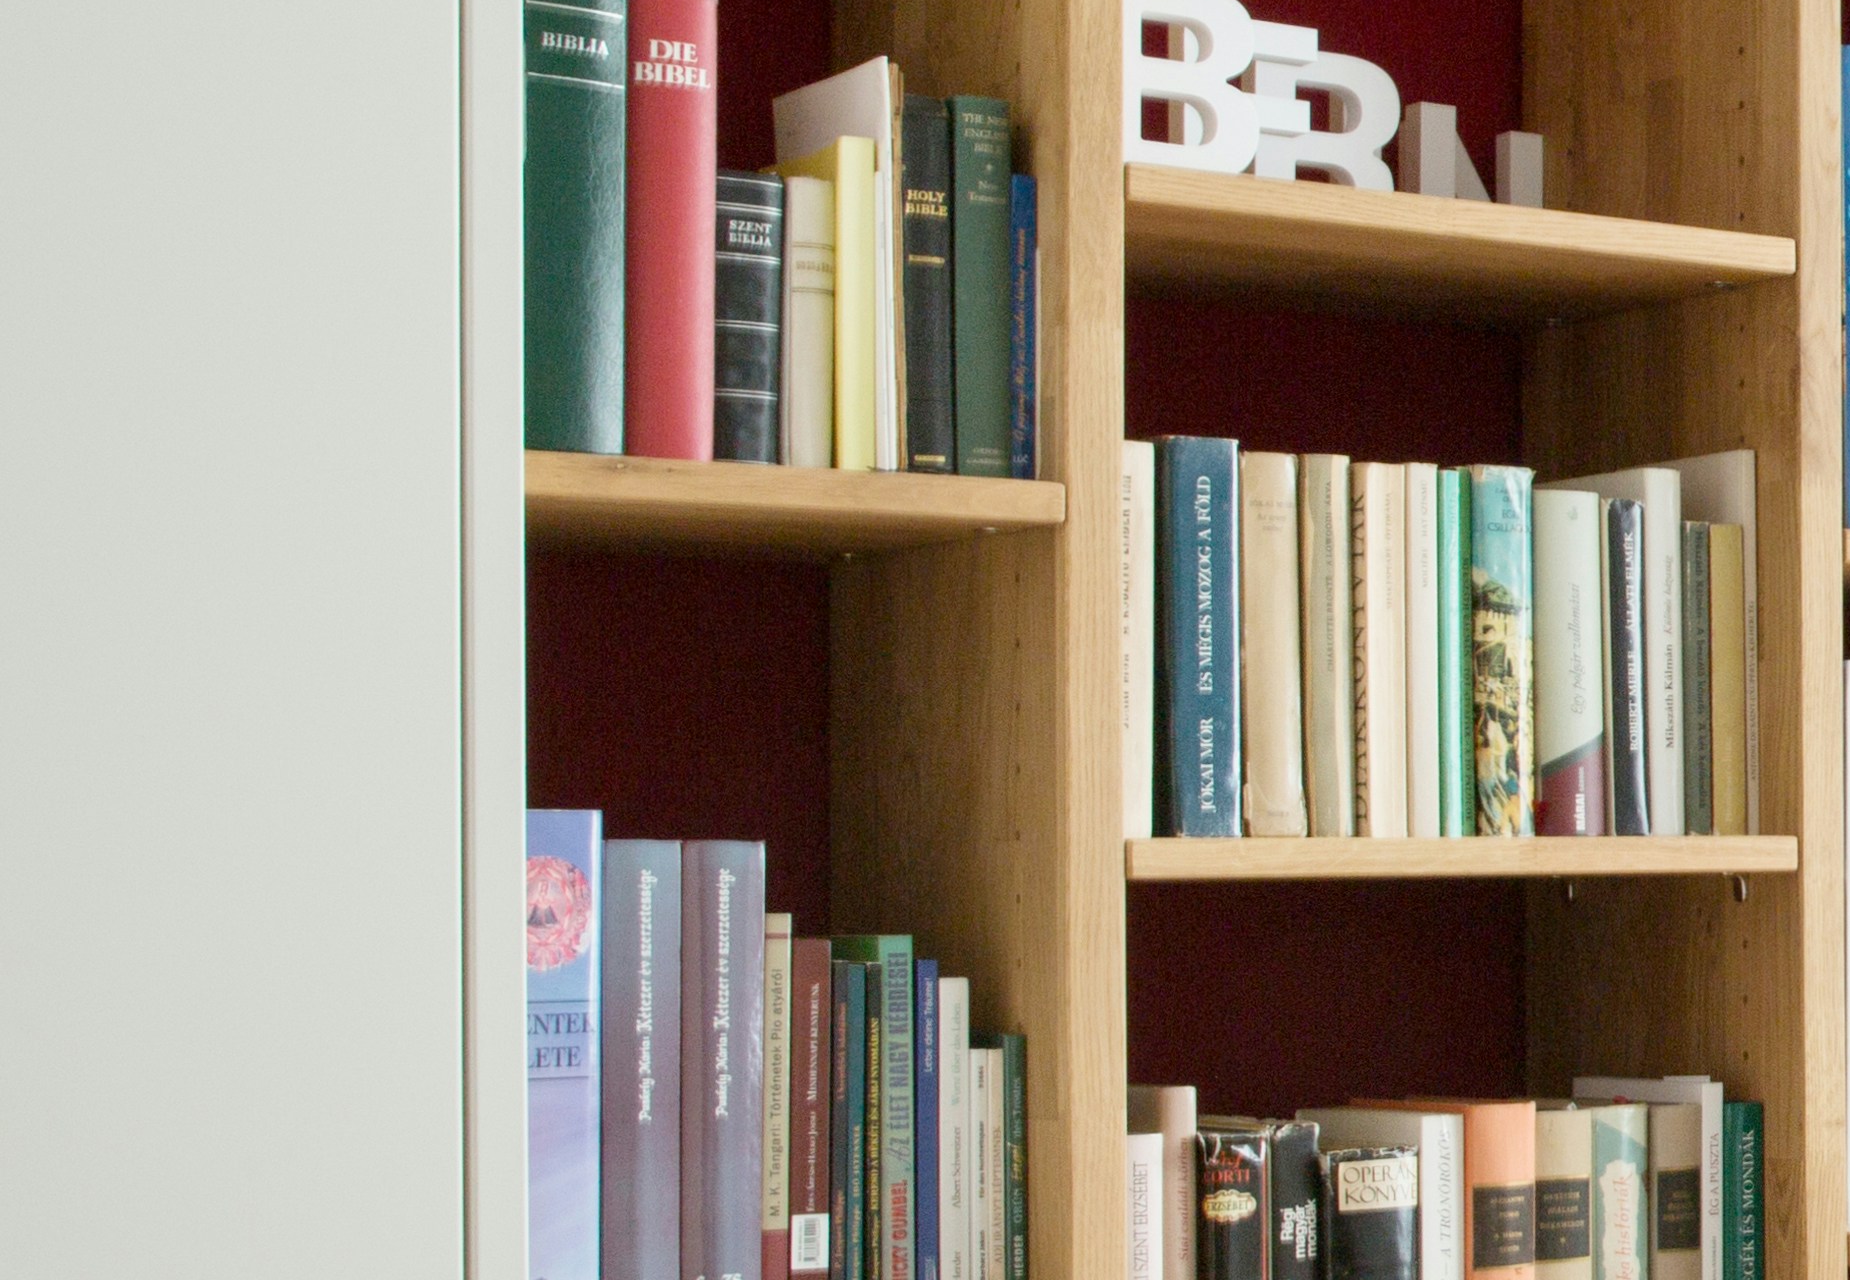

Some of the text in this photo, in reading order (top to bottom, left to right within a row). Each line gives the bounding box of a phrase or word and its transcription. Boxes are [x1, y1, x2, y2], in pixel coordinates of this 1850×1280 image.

[541, 31, 610, 57] BIBLIA
[649, 38, 698, 63] DIE
[633, 61, 712, 89] BIBEL
[906, 188, 945, 203] HOLY
[905, 202, 948, 218] BIBLE
[1196, 474, 1212, 523] FÖLD
[1198, 528, 1212, 542] A
[1196, 545, 1212, 611] MOZOG
[1199, 717, 1214, 758] MÓR
[1200, 762, 1216, 814] JÓKAI
[1279, 1207, 1295, 1244] Régi
